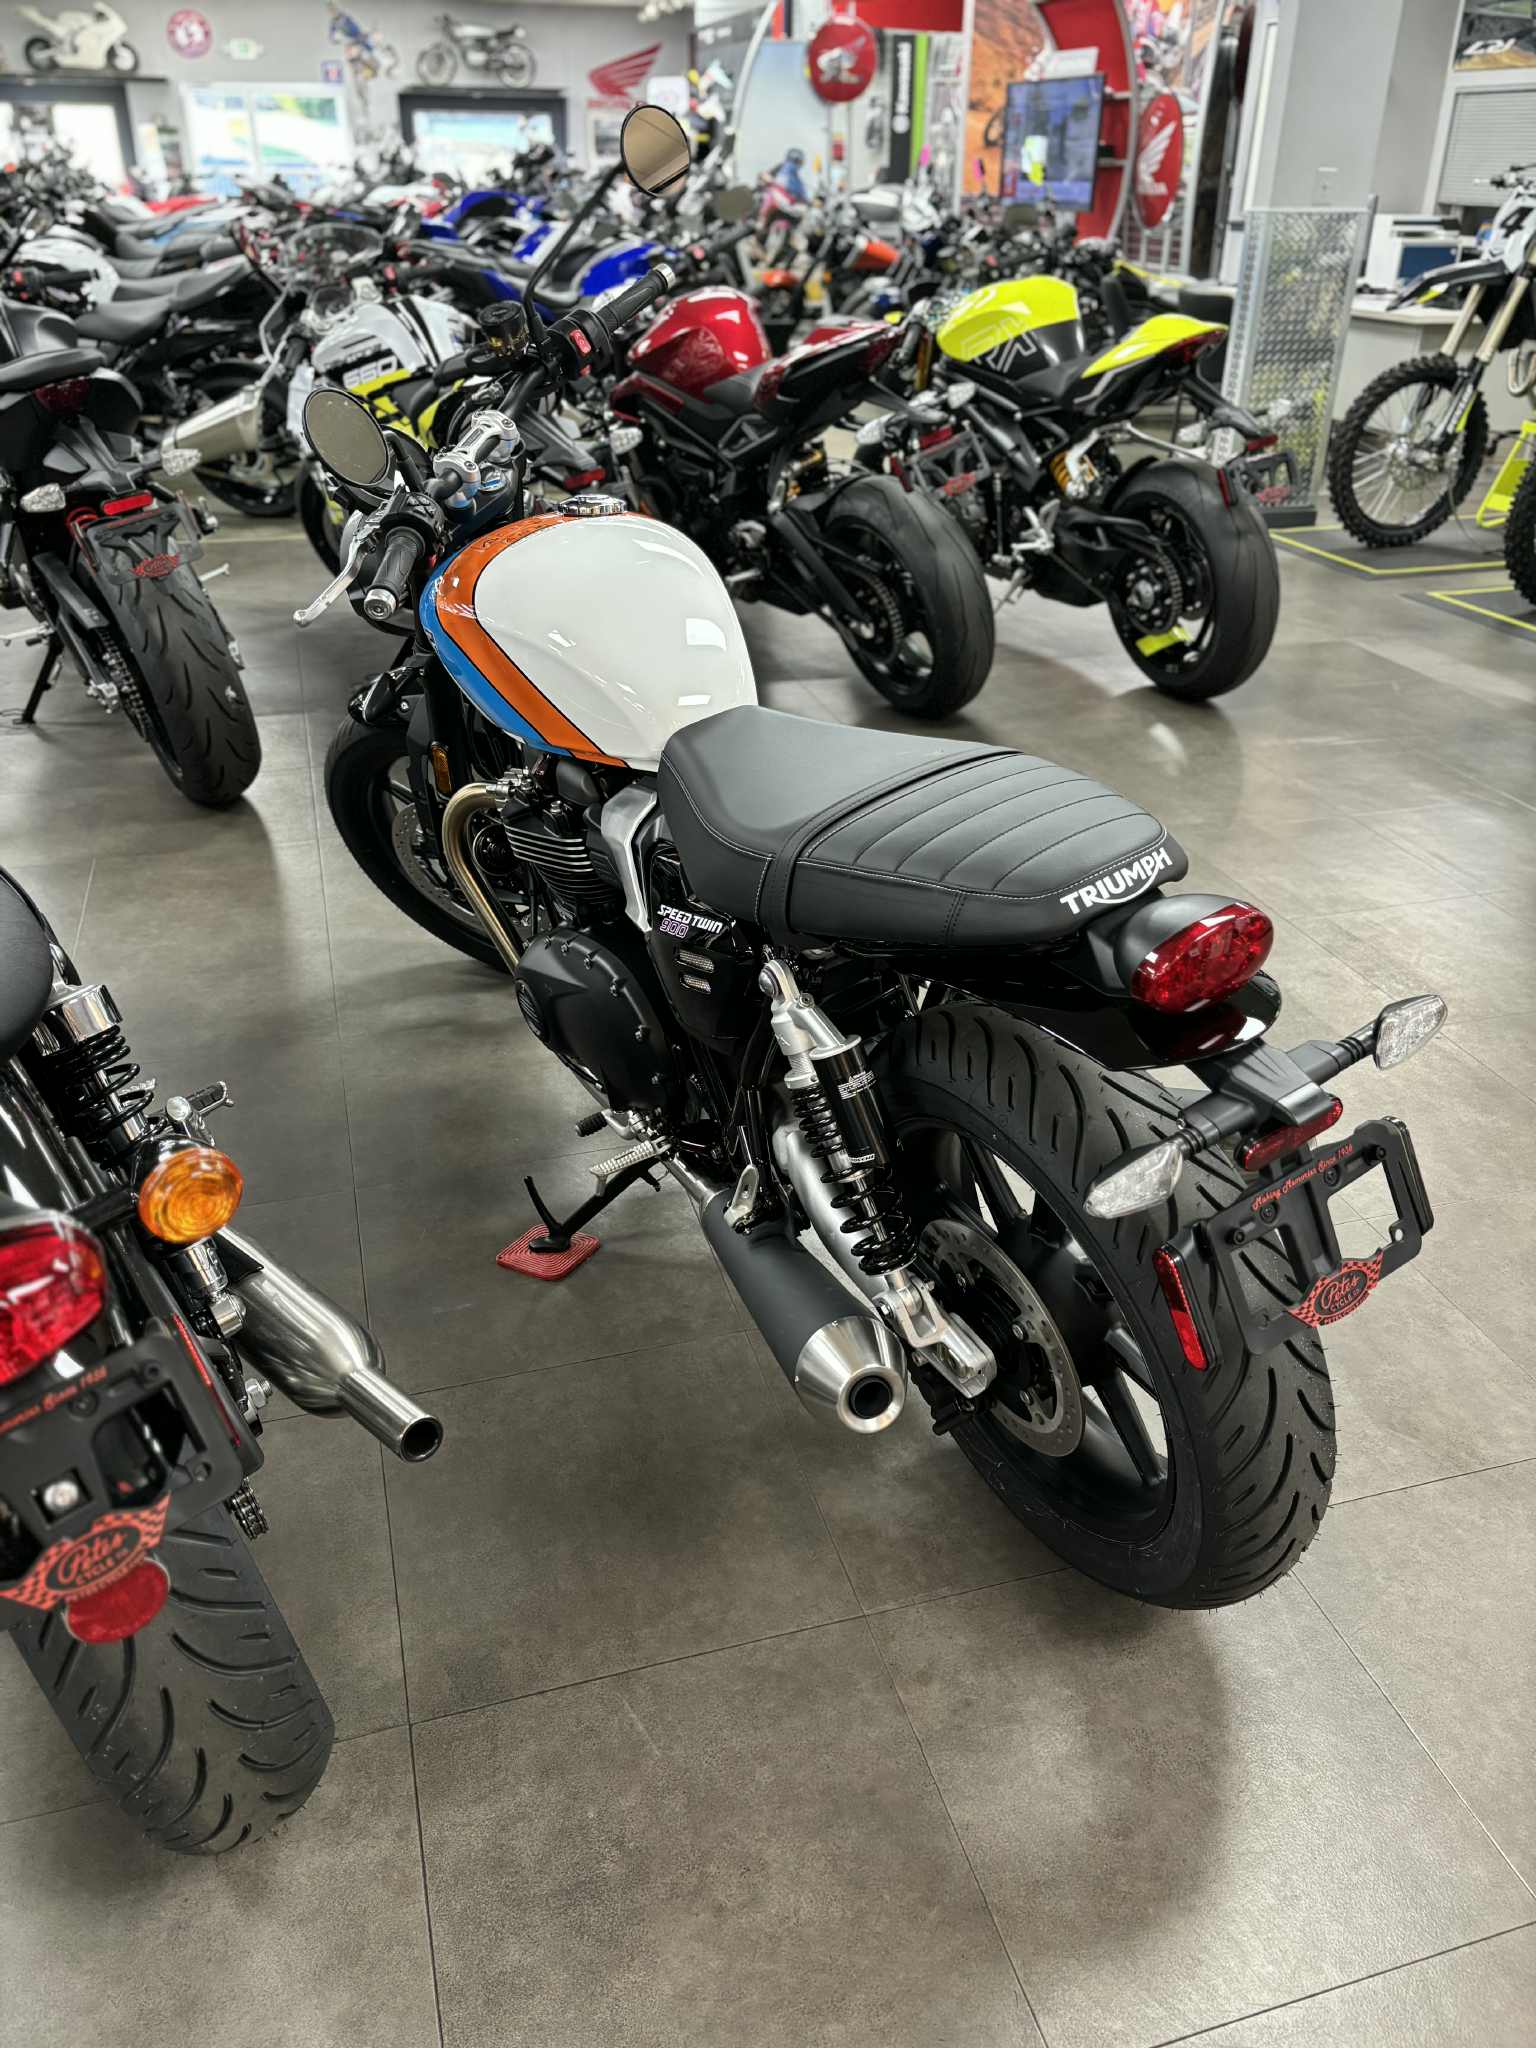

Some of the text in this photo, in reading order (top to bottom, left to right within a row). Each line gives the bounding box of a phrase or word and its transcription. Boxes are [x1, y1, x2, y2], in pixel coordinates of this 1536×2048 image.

[1500, 206, 1534, 238] 4
[1059, 847, 1173, 915] TRIUMPH
[657, 904, 723, 934] SPEED TWIN
[660, 917, 689, 939] 900
[1252, 1189, 1281, 1211] Making
[1283, 1168, 1317, 1193] Memories
[1329, 1294, 1353, 1312] CYCLE
